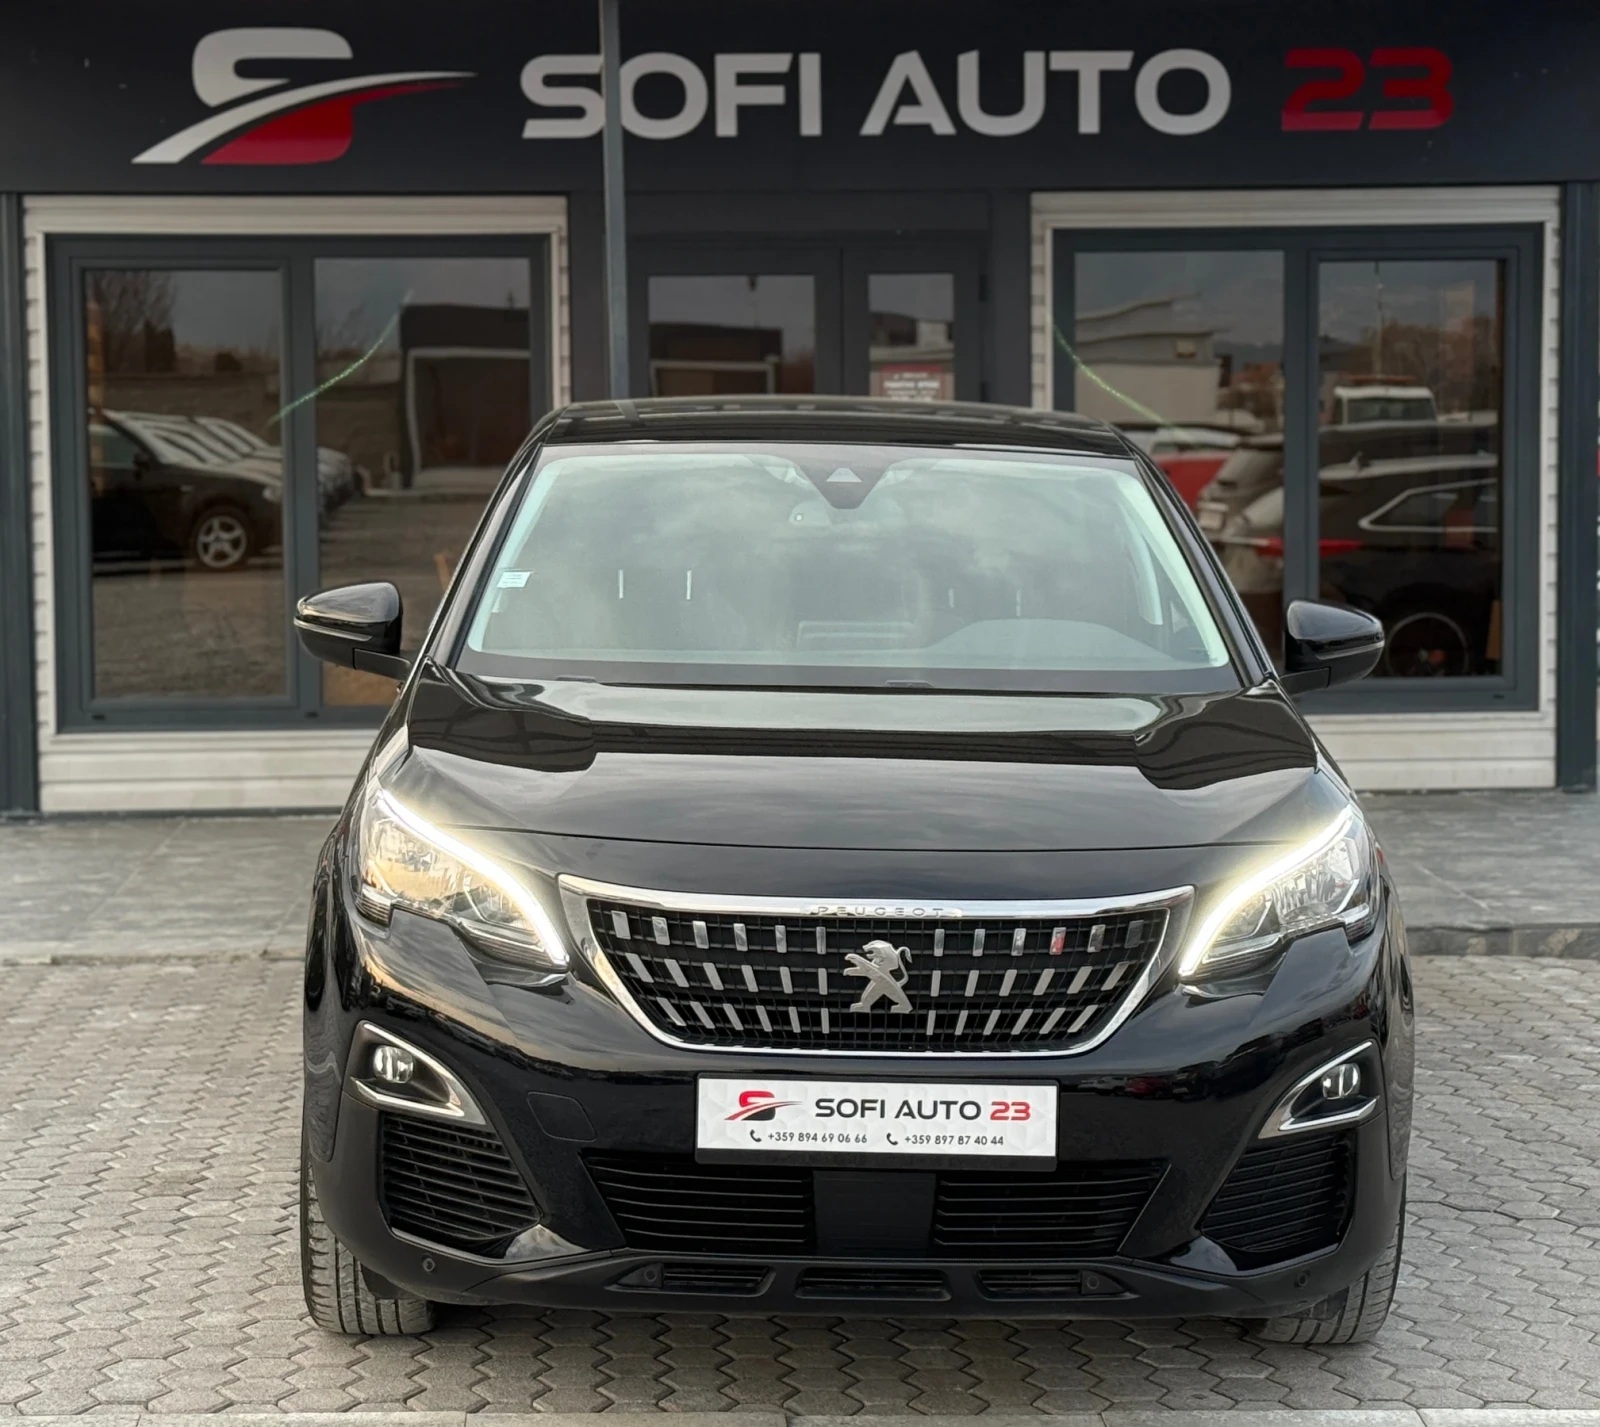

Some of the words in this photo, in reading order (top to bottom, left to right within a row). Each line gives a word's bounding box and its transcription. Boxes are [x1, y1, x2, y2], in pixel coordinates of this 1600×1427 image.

[520, 52, 821, 139] SOFI
[860, 49, 1231, 136] AUTO
[1281, 47, 1454, 132] 23
[817, 906, 944, 917] PEUGEOT
[815, 1098, 886, 1119] SOFI
[894, 1099, 982, 1121] AUTO
[989, 1101, 1031, 1121] 23
[768, 1132, 795, 1143] +359
[797, 1132, 818, 1143] 894
[821, 1133, 834, 1143] 69
[837, 1133, 851, 1144] 06
[854, 1134, 868, 1144] 66
[905, 1134, 931, 1145] +359
[934, 1135, 955, 1145] 897
[957, 1135, 971, 1145] 87
[974, 1135, 988, 1146] 40
[990, 1136, 1004, 1146] 44
